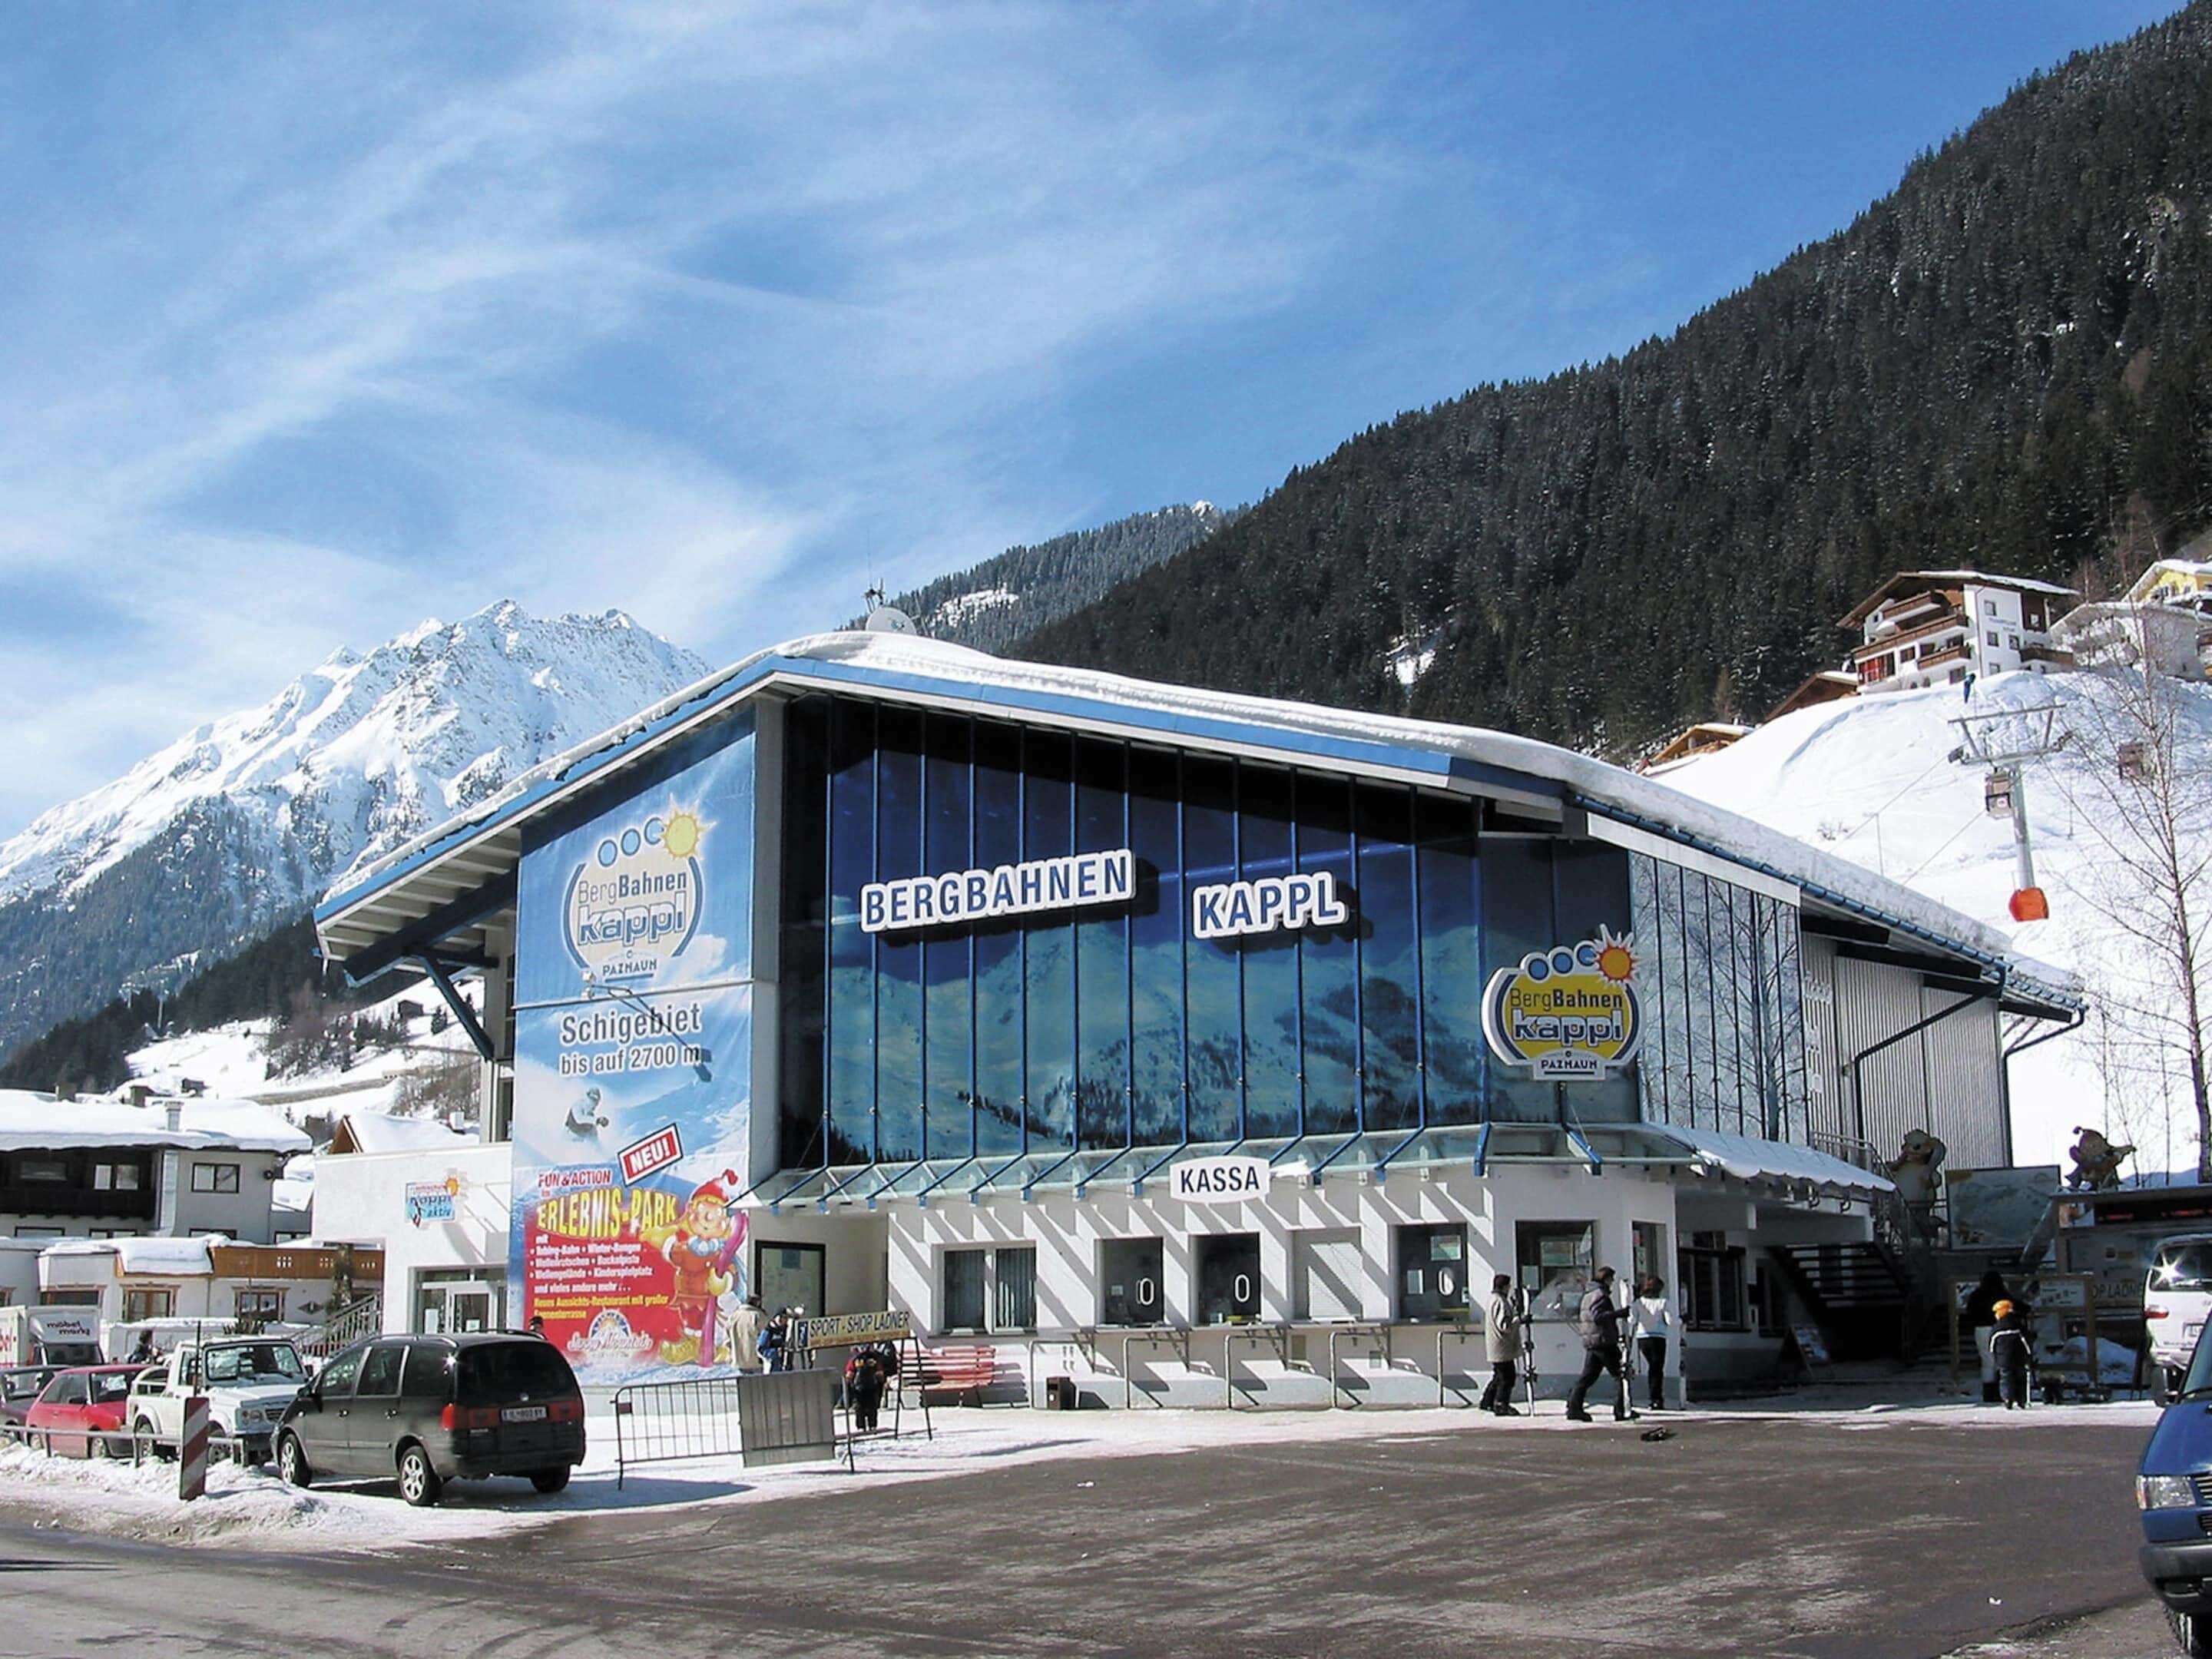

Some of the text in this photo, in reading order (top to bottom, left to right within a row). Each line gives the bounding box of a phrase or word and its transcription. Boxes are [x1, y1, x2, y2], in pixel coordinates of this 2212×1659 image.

[578, 871, 687, 905] BergBahnen
[865, 853, 1345, 935] BERGBAHNEN KAPPL
[602, 960, 657, 975] PAZNAUN
[1510, 988, 1623, 1011] BergBahnen
[561, 1002, 701, 1044] Schigebiet
[561, 1045, 701, 1075] bis auf 2700 m
[1541, 1060, 1598, 1069] PAZNAUN
[629, 1134, 671, 1174] NEU!
[538, 1173, 560, 1187] FUN
[571, 1170, 611, 1185] ACTION
[1180, 1165, 1260, 1194] KASSA
[537, 1187, 678, 1238] ERLEBNIS-PARK
[810, 1317, 841, 1338] SPORT
[847, 1314, 874, 1334] SHOP
[874, 1310, 911, 1332] LADNER
